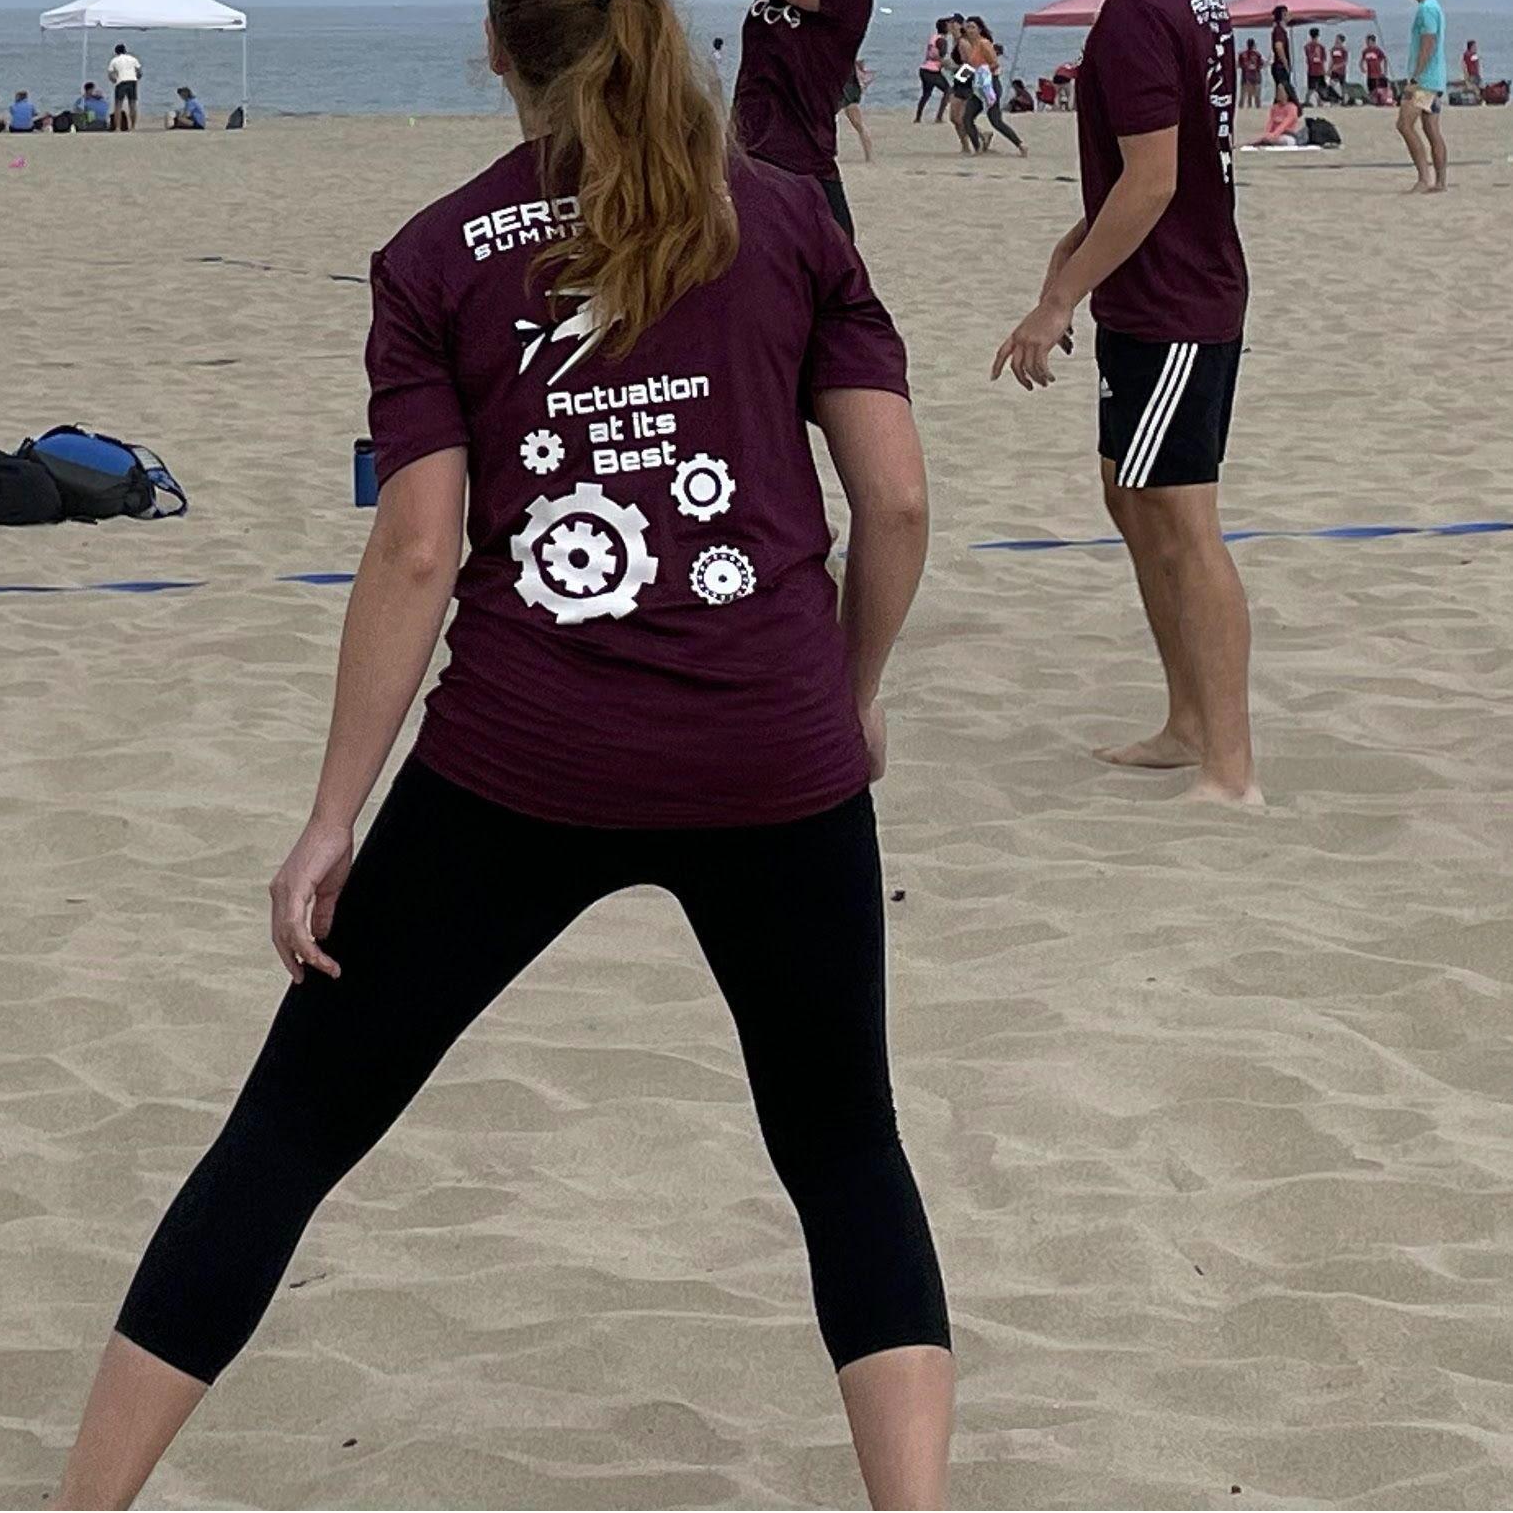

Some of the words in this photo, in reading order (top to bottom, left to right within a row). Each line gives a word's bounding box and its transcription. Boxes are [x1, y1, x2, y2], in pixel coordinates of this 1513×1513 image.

[546, 374, 710, 418] Actuation
[588, 415, 624, 444] at
[631, 410, 677, 439] its
[592, 440, 677, 475] Best
